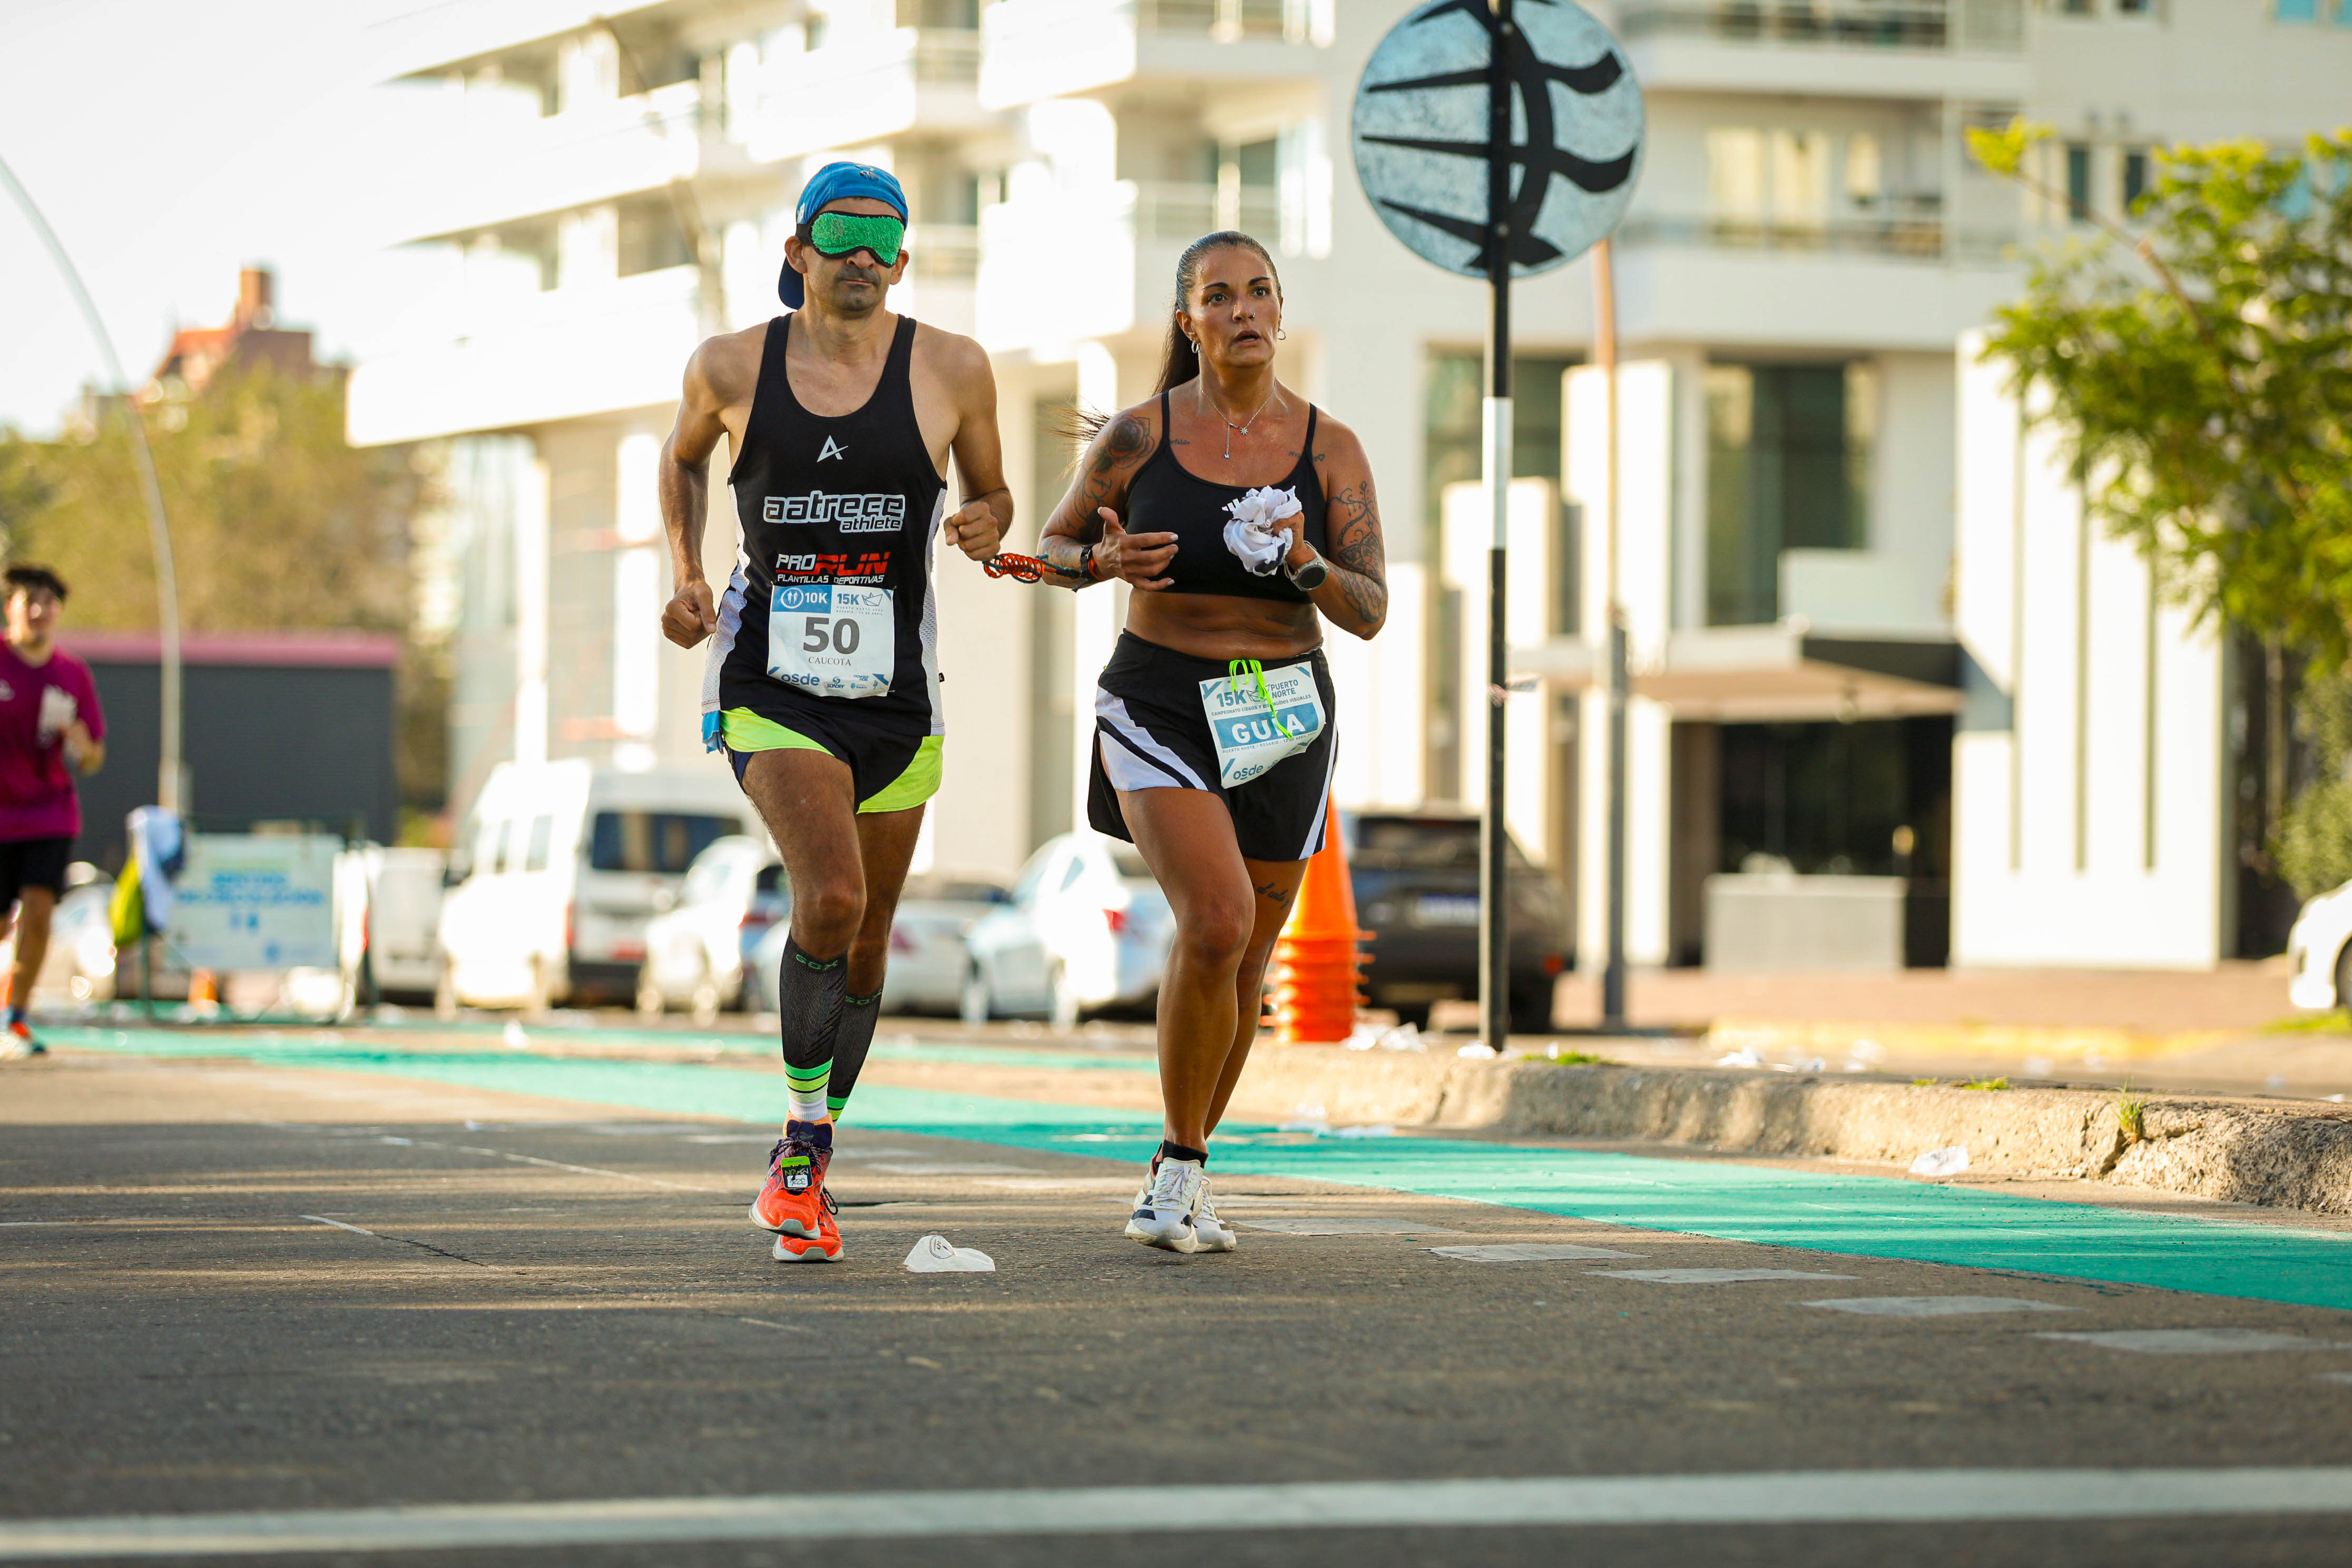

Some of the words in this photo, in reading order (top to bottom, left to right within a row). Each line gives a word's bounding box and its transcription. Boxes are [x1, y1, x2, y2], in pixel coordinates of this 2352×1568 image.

[763, 491, 905, 523] aatrece
[840, 515, 903, 533] athlete
[777, 574, 829, 583] PLANTILLAS
[834, 575, 885, 584] DEPORTIVAS
[805, 592, 828, 604] 10K
[837, 593, 860, 605] 15K
[803, 616, 860, 654] 50
[808, 656, 852, 666] CAUCOTA
[781, 673, 820, 685] osde
[1270, 679, 1299, 691] PUERTO
[1217, 690, 1247, 707] 15K
[1272, 688, 1296, 699] NORTE
[1212, 708, 1241, 716] CAMPEONATO
[1289, 694, 1311, 702] VISUALES
[1233, 764, 1263, 780] osde
